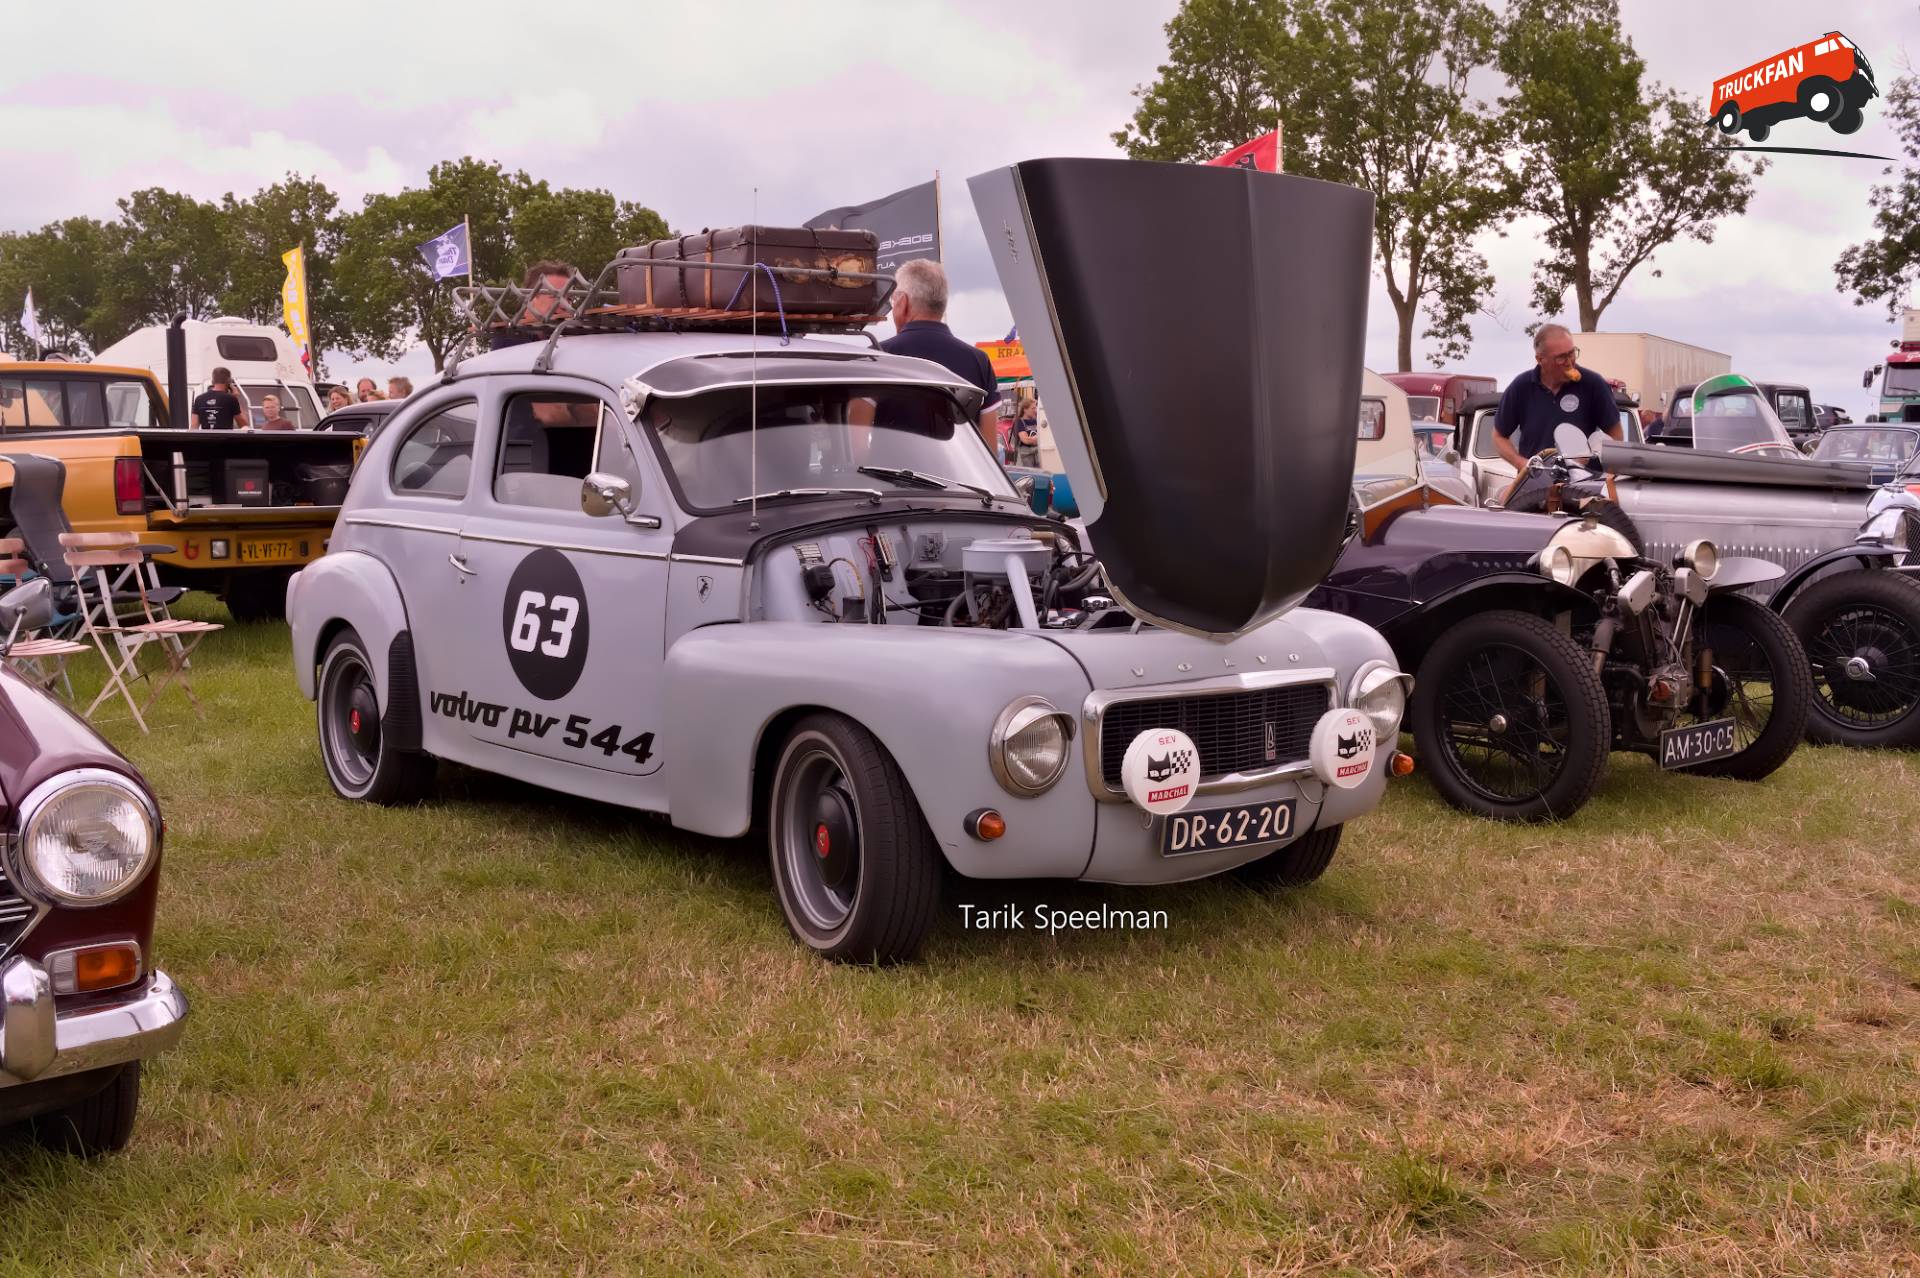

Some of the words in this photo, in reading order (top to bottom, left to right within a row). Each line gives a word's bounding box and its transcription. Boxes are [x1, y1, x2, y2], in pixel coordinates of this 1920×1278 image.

[511, 590, 579, 658] 63
[1131, 654, 1300, 677] VOLVO
[430, 691, 509, 727] volvo
[508, 708, 561, 738] pv
[562, 714, 656, 764] 544
[1158, 735, 1176, 745] SEV
[1150, 786, 1188, 801] MARCHAL
[1170, 804, 1291, 851] DR-62-20
